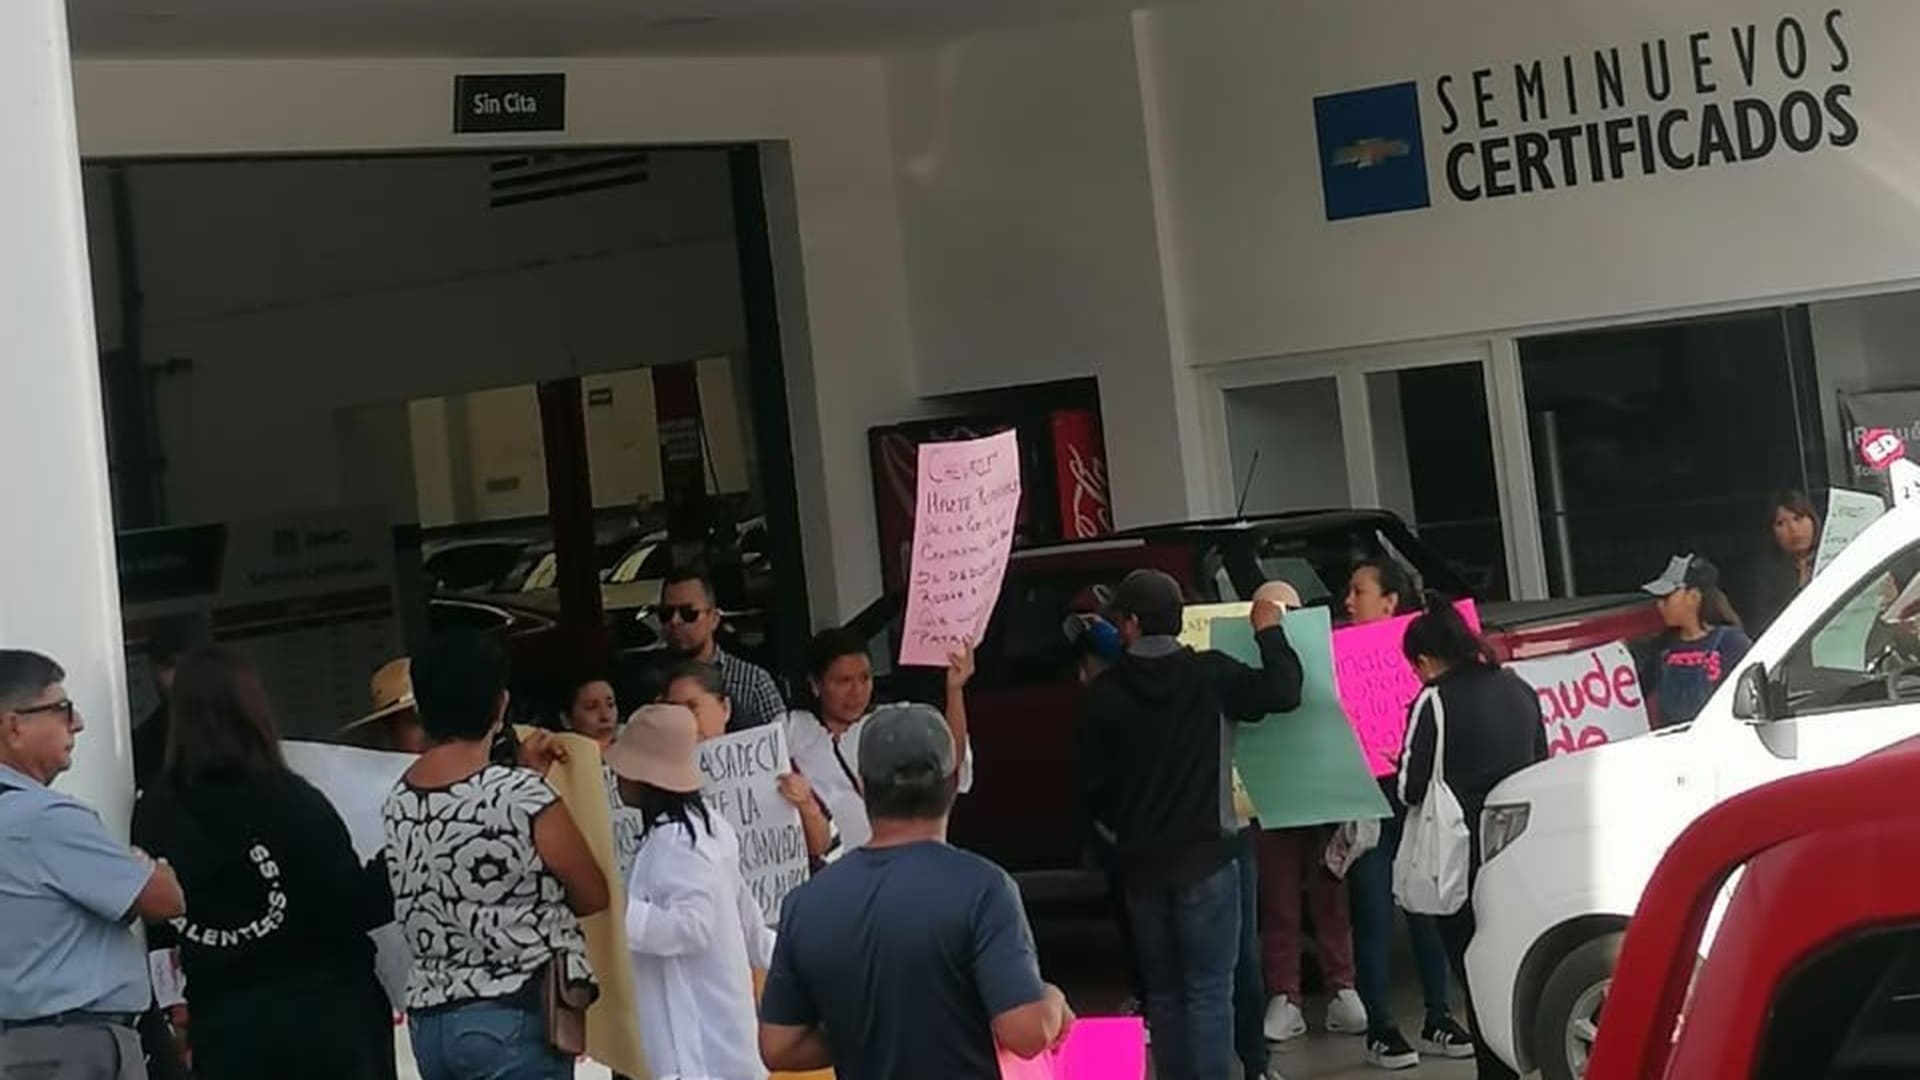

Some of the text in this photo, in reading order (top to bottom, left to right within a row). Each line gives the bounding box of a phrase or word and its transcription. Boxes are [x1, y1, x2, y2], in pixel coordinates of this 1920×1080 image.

[473, 92, 537, 114] Sin Cita
[1436, 9, 1850, 135] SEMINUEVOS
[1445, 84, 1860, 201] CERTIFICADOS
